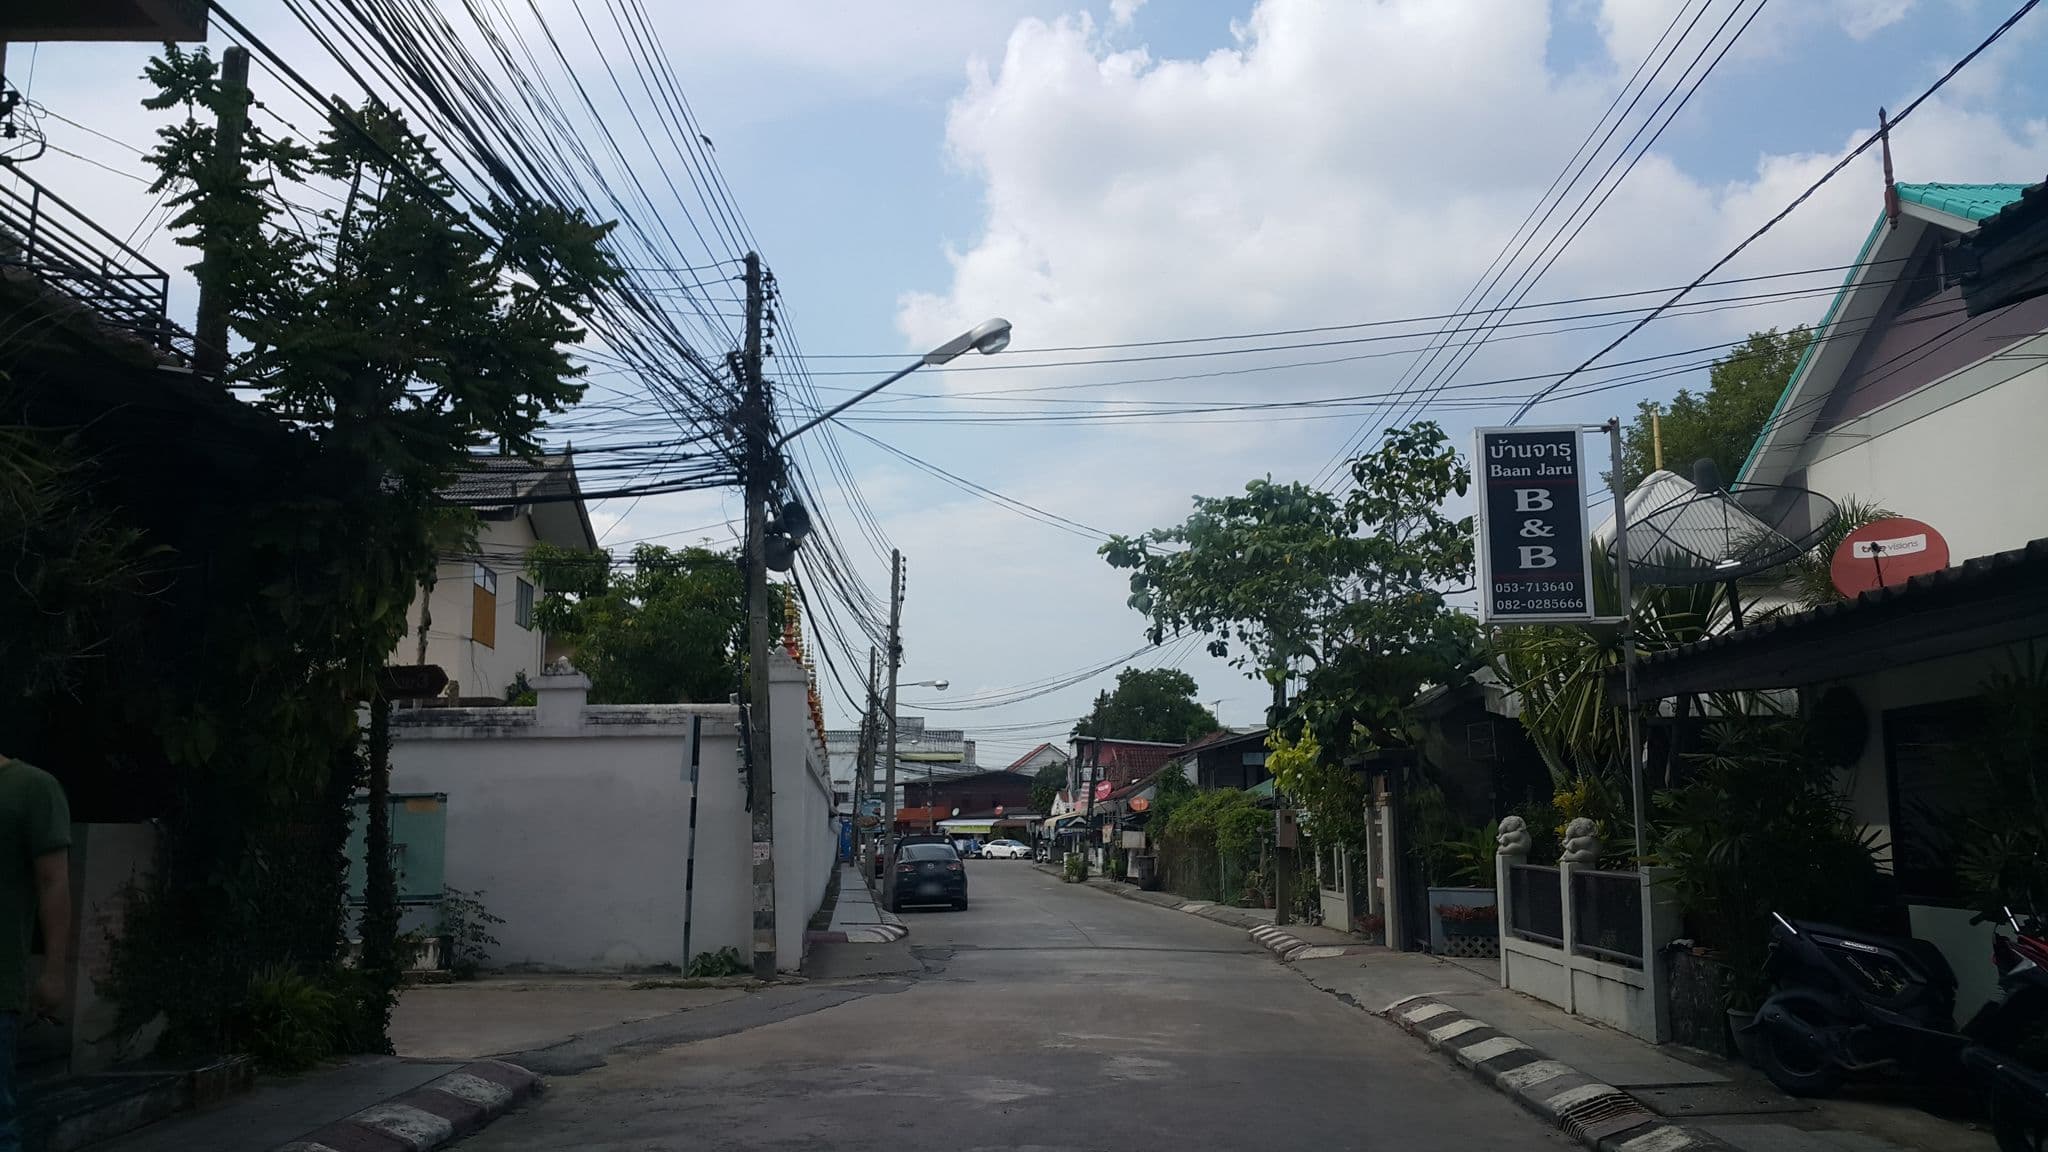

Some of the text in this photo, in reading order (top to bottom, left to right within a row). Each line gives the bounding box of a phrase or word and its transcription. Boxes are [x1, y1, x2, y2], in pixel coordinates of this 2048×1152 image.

[1490, 439, 1571, 461] บ้านจารุ
[1491, 463, 1572, 477] Baan Jaru
[1514, 488, 1554, 512] B
[1519, 518, 1555, 537] &
[1518, 546, 1557, 569] B
[1495, 582, 1574, 593] 053-713640
[1497, 598, 1584, 609] 082-0285666
